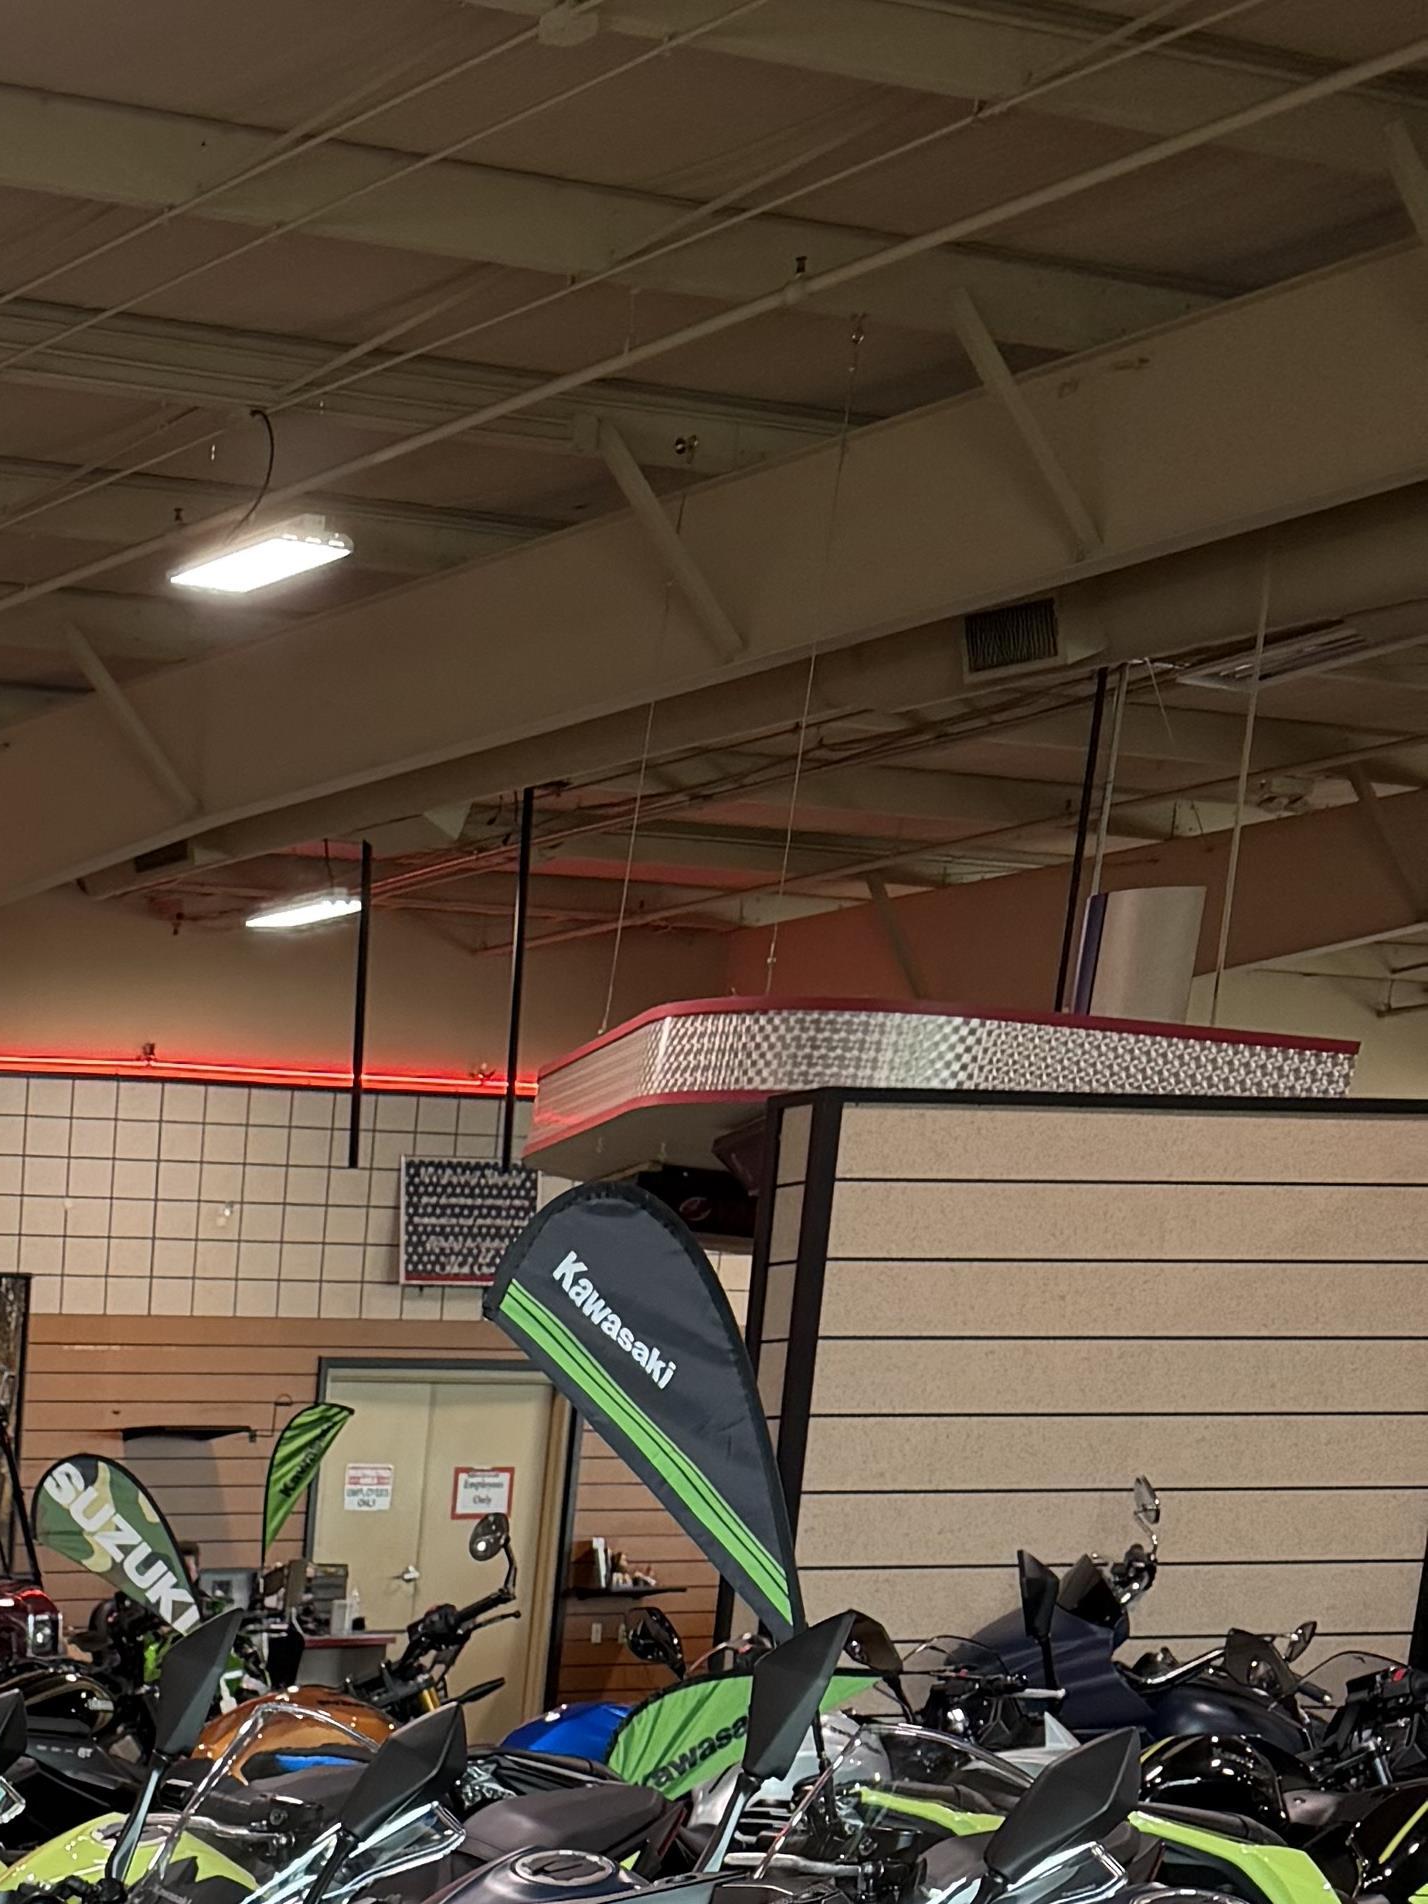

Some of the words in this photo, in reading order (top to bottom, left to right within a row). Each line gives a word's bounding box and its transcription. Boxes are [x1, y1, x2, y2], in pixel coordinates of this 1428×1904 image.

[552, 1251, 677, 1390] Kawasaki
[44, 1463, 200, 1636] SUZUKI
[643, 1716, 748, 1787] awasa
